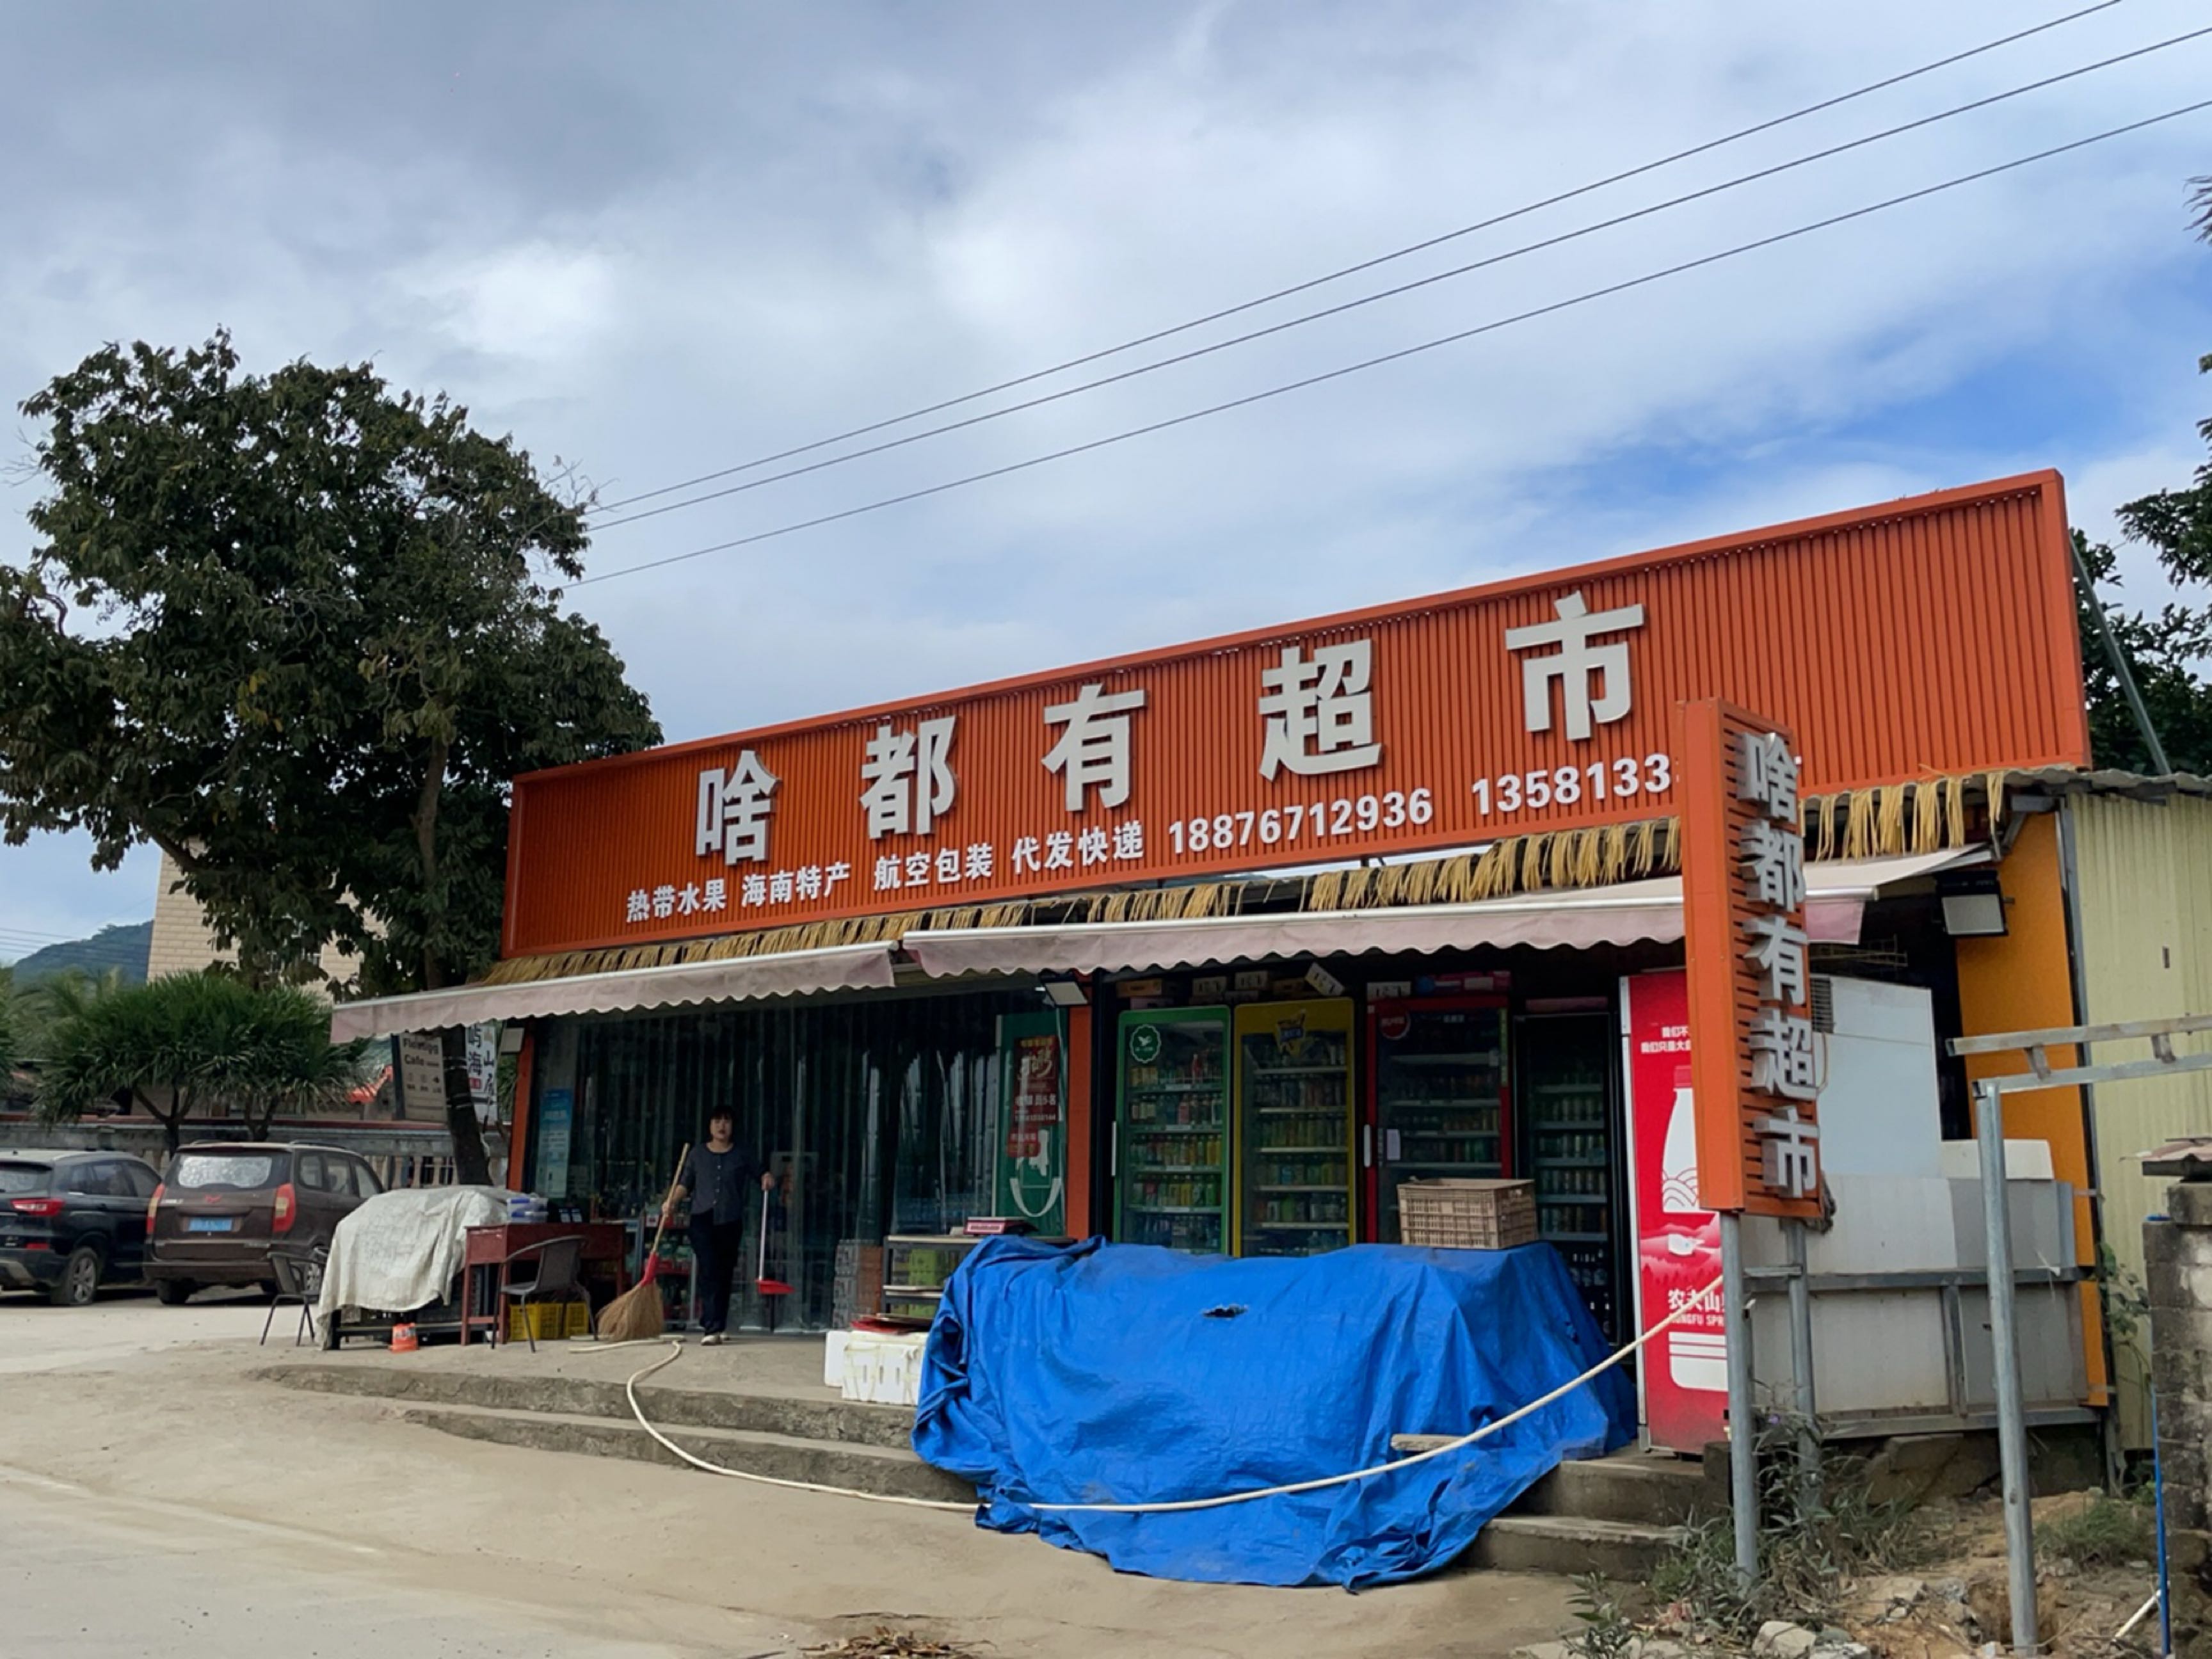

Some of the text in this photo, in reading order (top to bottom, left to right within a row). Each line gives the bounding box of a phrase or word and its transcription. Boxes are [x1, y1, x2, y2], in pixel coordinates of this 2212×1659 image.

[626, 753, 1680, 923] 热带水果 海南特产 航空包装 代发快递 18876712936 1358133
[695, 590, 1644, 866] 啥都有超市
[1737, 732, 1821, 1199] 啥都有超市
[1667, 1287, 1725, 1313] 农夫山
